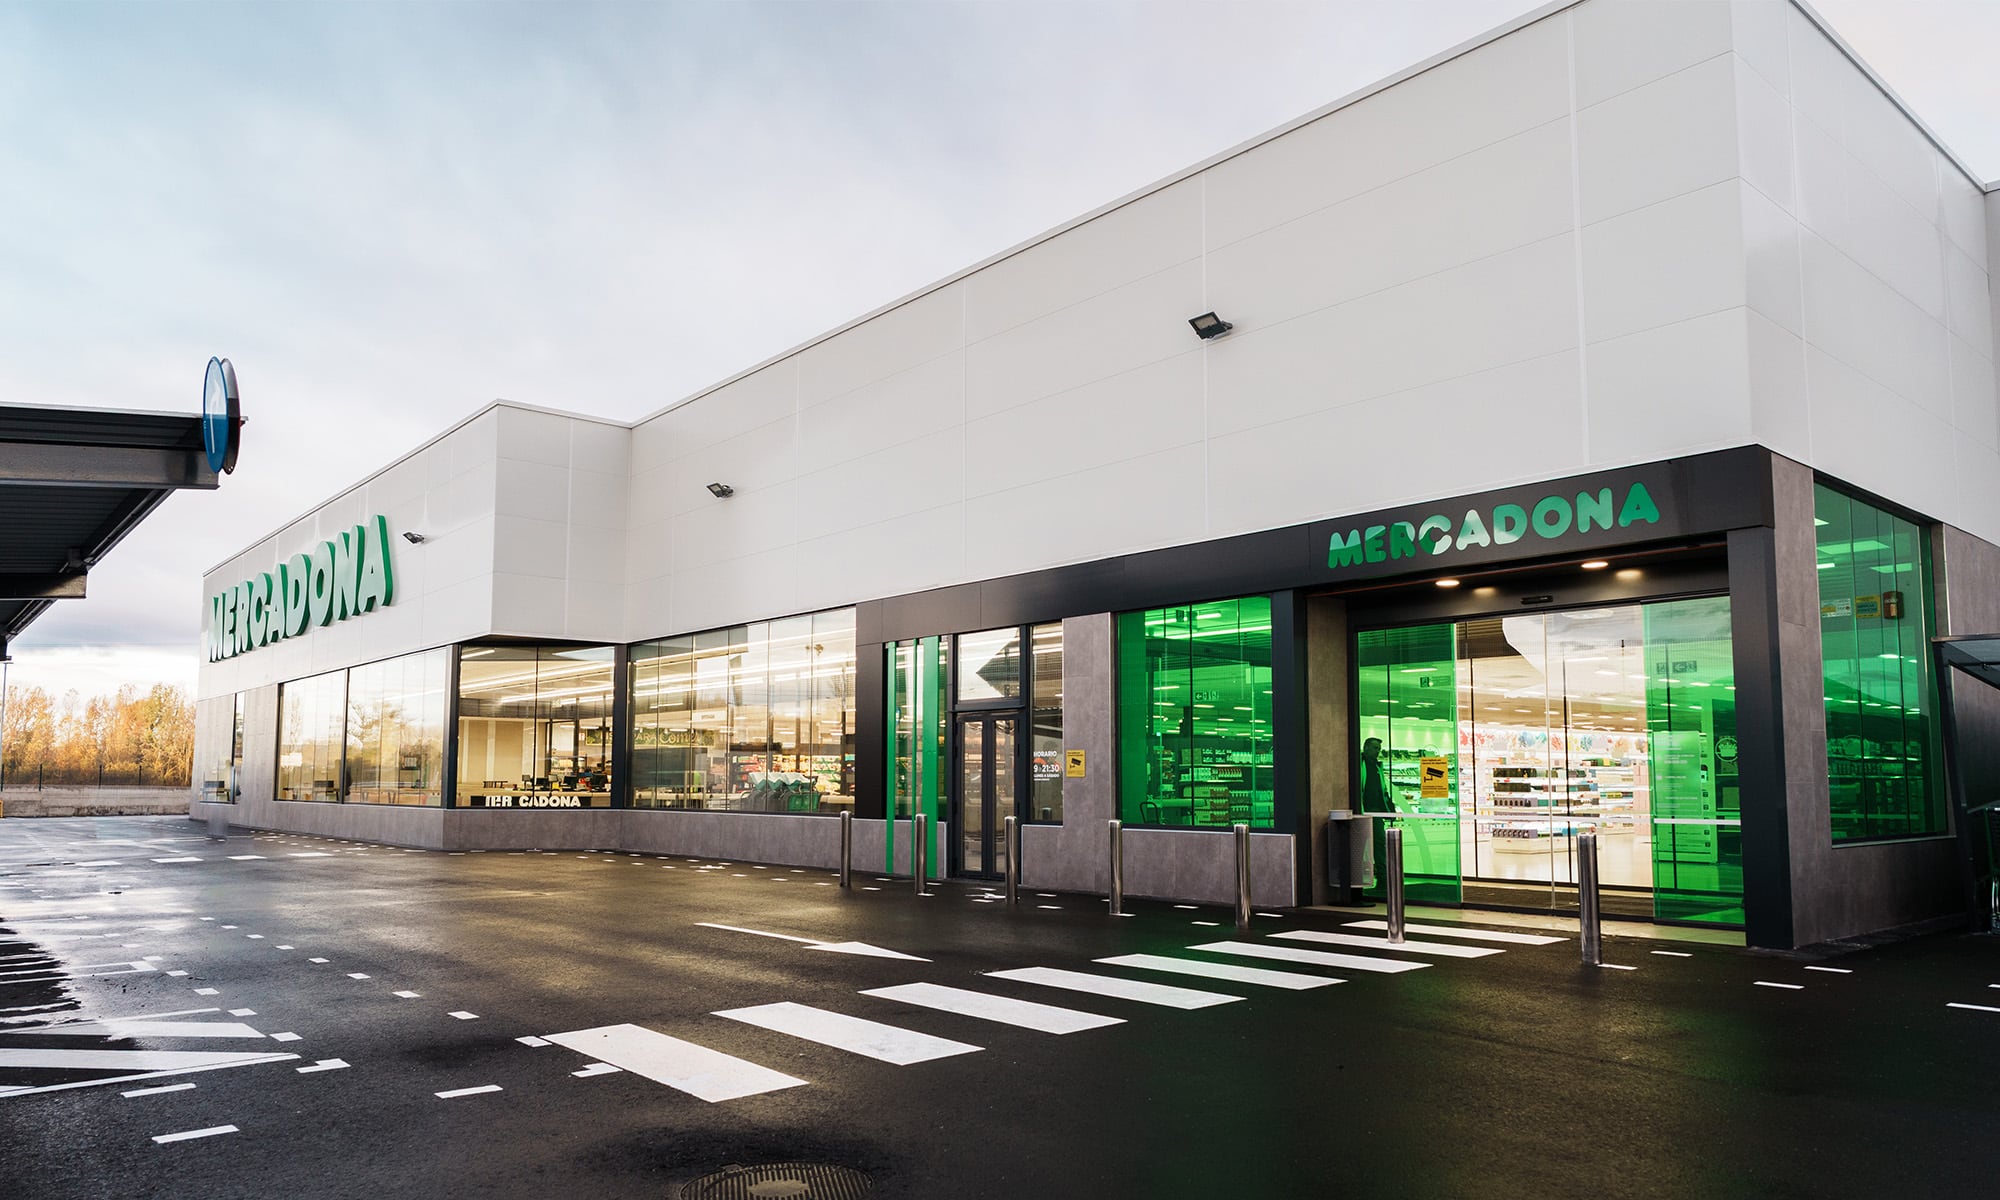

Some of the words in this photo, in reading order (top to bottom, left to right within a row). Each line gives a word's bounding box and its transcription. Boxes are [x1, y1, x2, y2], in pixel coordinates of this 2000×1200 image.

[1328, 482, 1660, 568] MERCADONA
[208, 515, 392, 662] MERCADONA
[1042, 764, 1060, 772] 21:30
